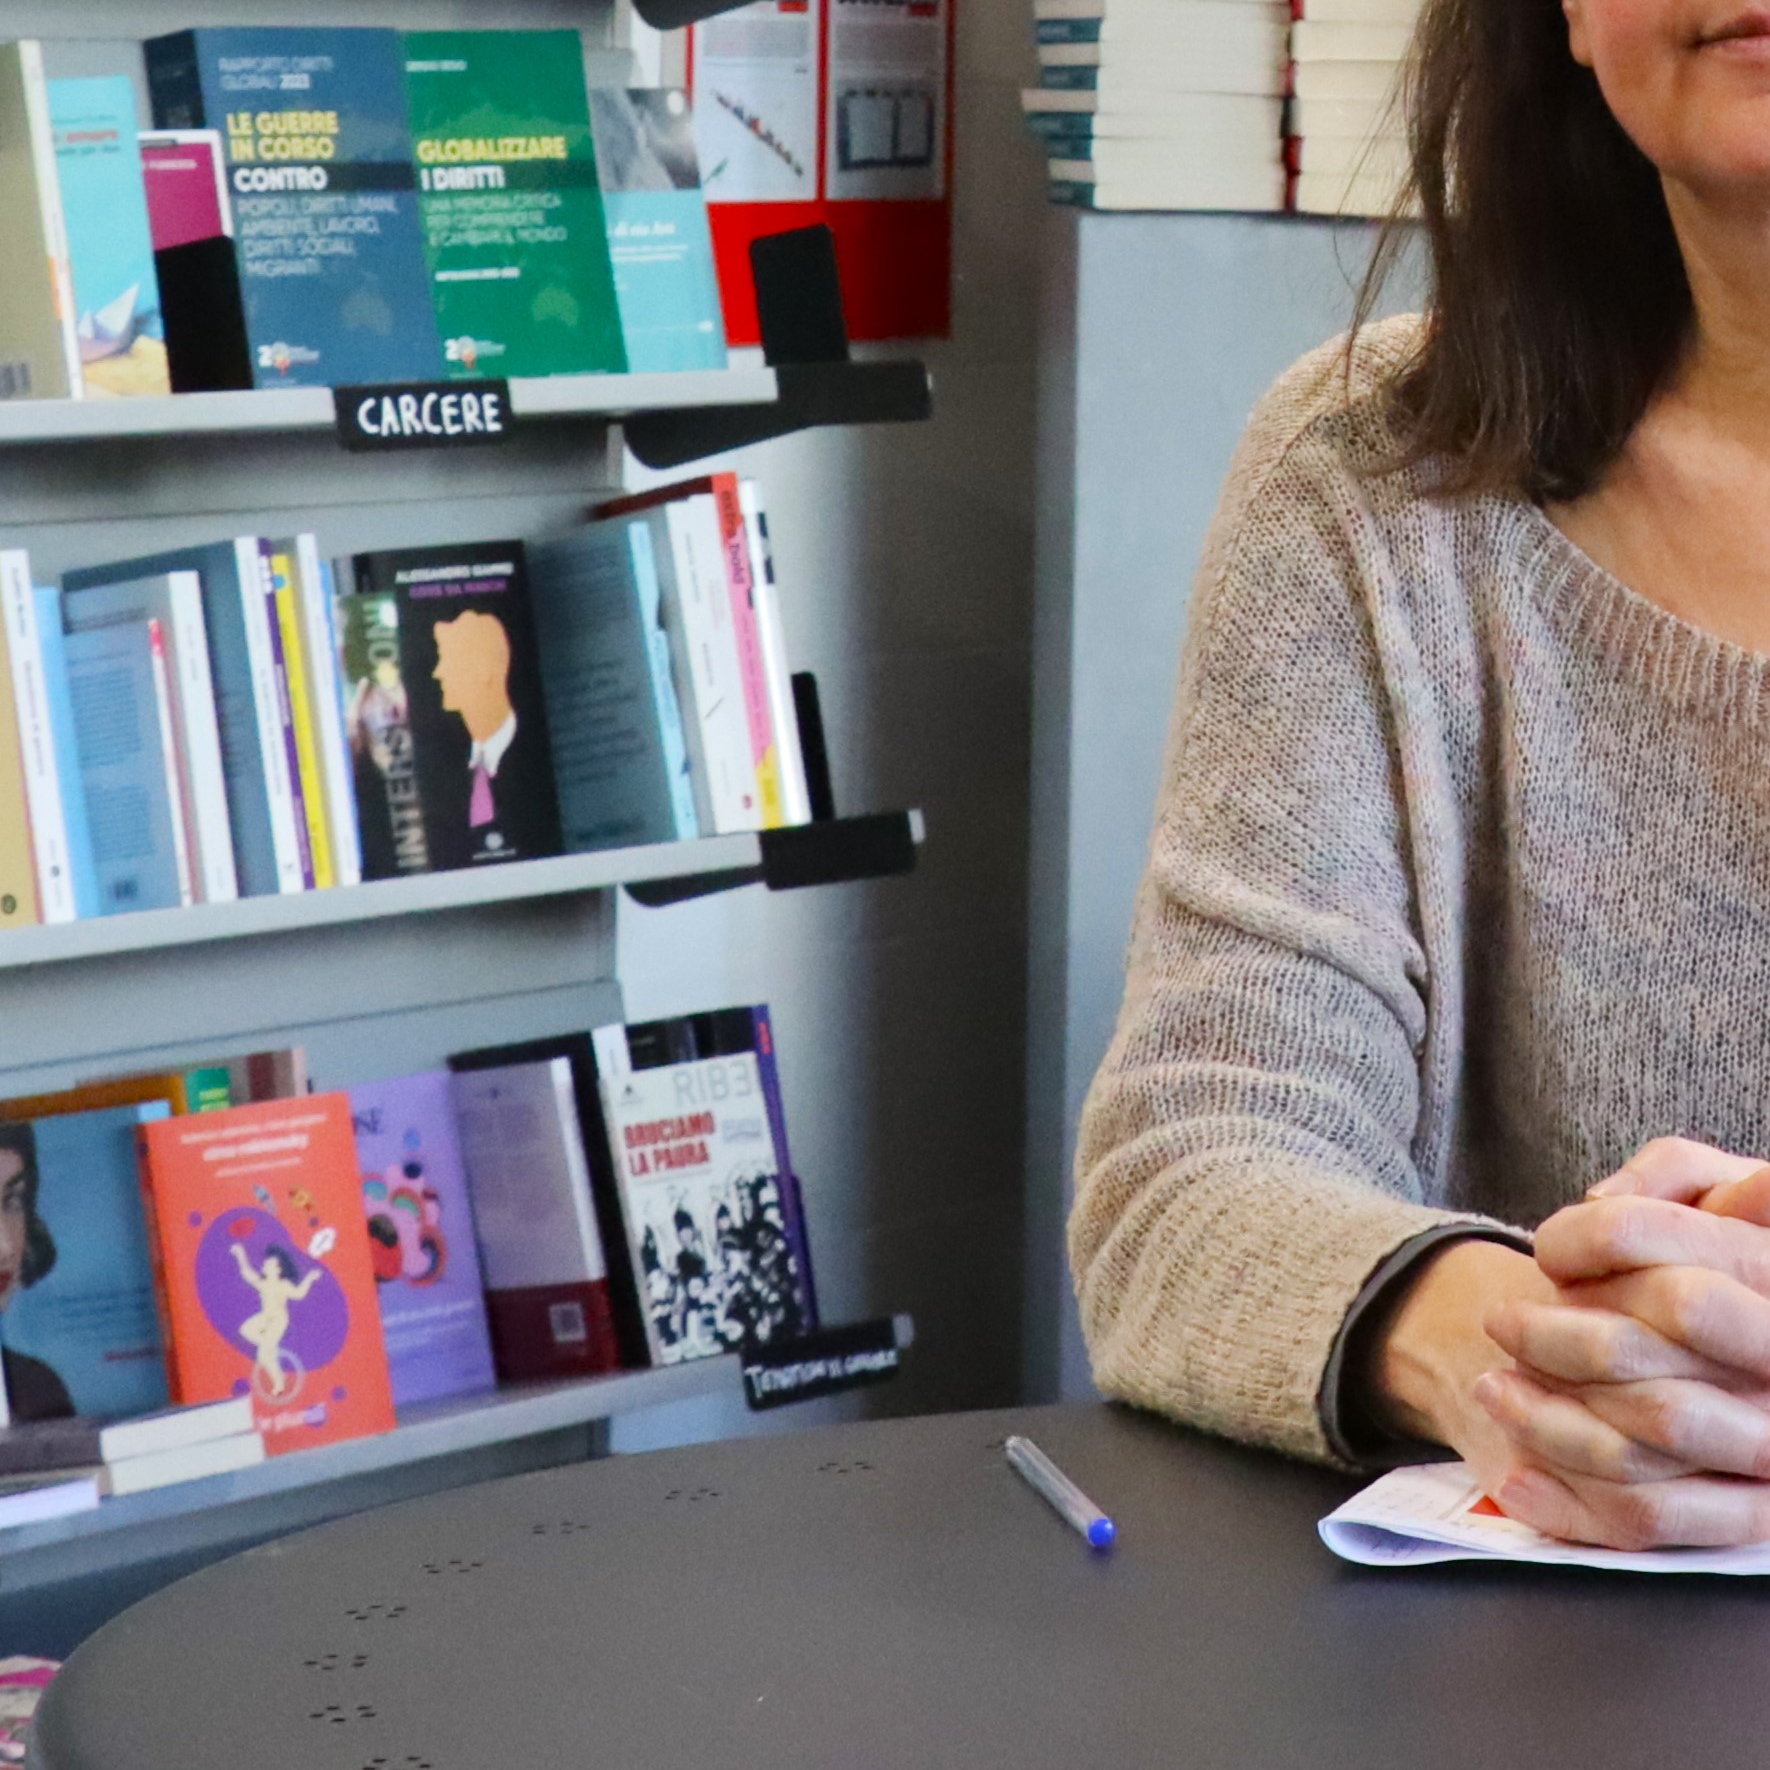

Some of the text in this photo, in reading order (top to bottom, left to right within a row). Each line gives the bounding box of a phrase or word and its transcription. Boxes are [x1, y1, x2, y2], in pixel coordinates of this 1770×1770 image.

[226, 110, 340, 136] LE GUERRE
[230, 136, 336, 161] IN CORSO
[417, 136, 568, 163] GLOBALIZZARE
[233, 166, 329, 192] CONTRO
[421, 165, 506, 191] I DIRITTI
[357, 392, 503, 437] CARCERE
[720, 490, 737, 540] extra
[624, 1110, 715, 1149] BRUCIAMO
[629, 1141, 709, 1177] LA PAURA
